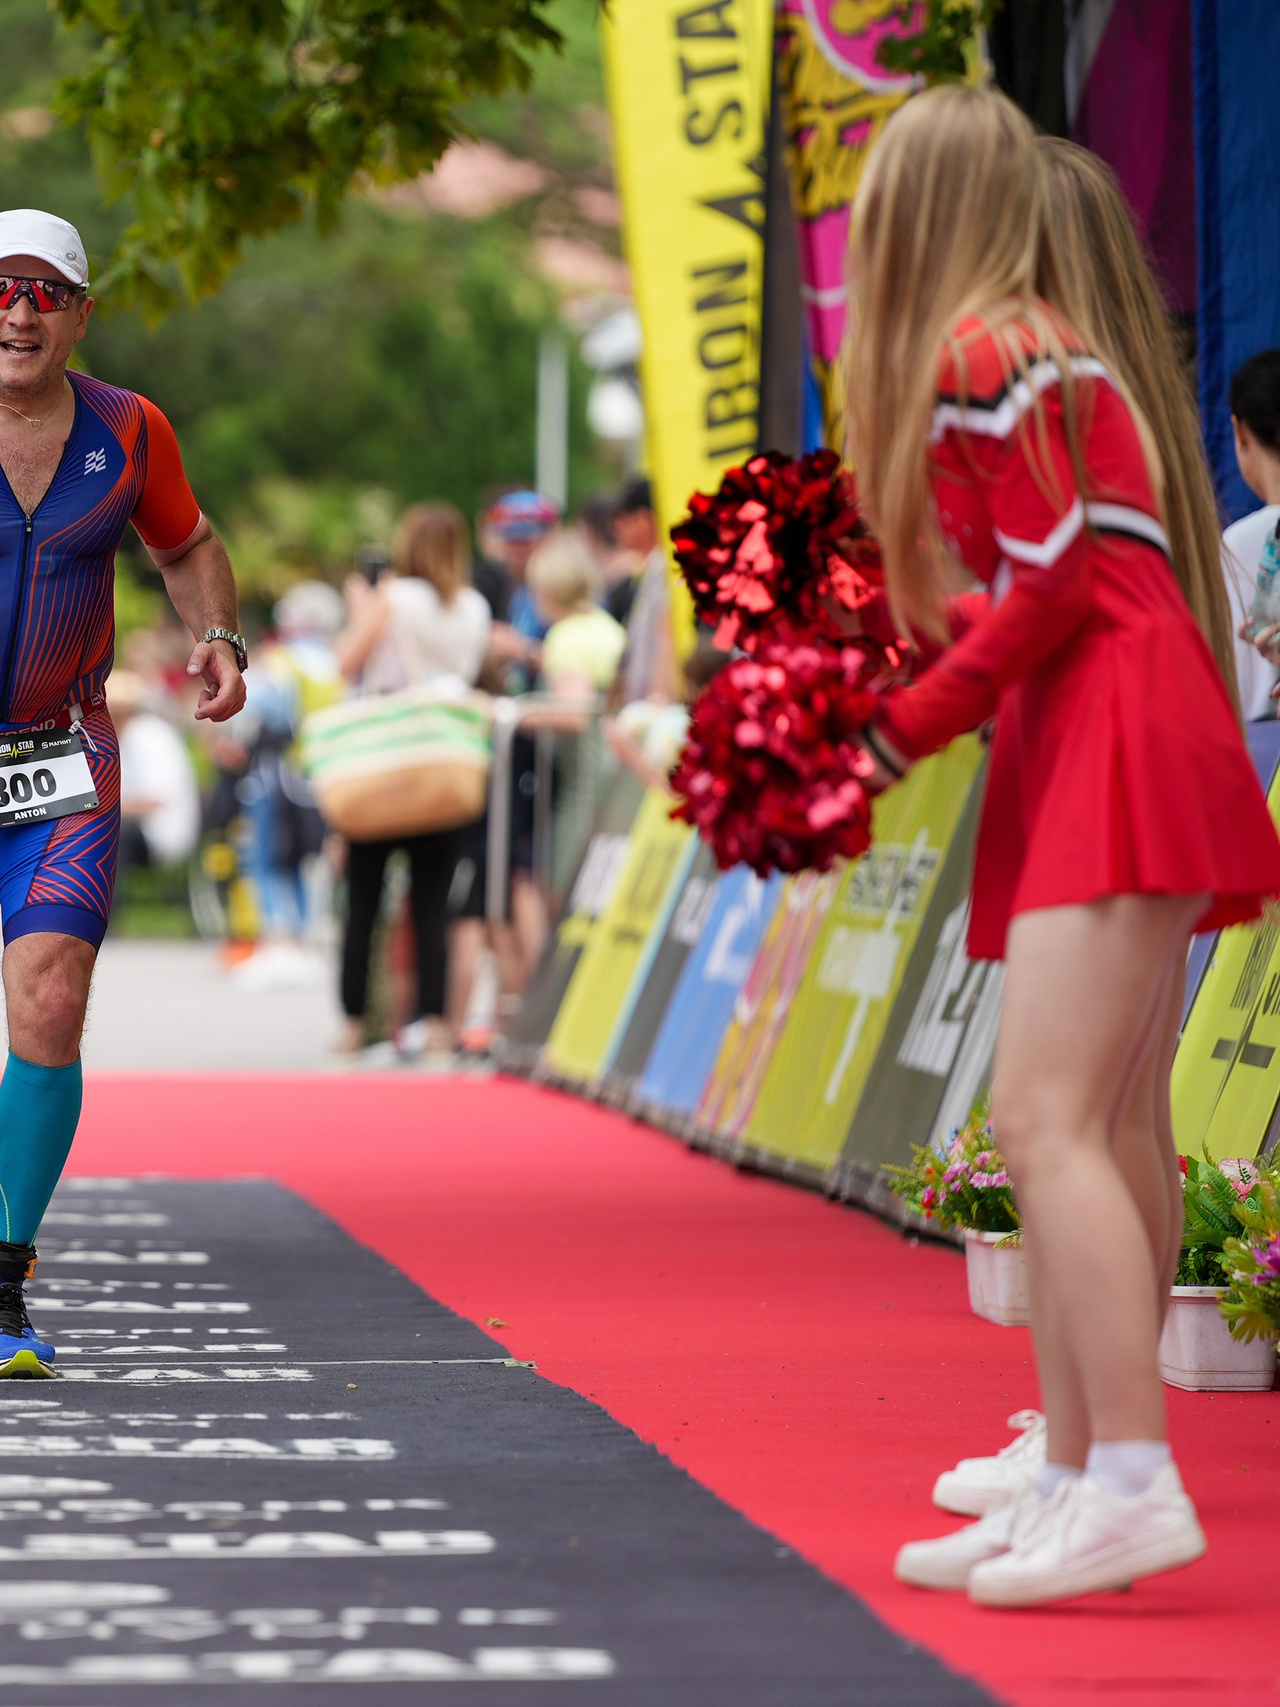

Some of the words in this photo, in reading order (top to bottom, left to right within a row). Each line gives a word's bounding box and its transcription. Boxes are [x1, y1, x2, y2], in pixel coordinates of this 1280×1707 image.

[17, 740, 35, 751] STAR
[48, 738, 72, 748] МАГНИТ
[14, 807, 48, 820] ANTON
